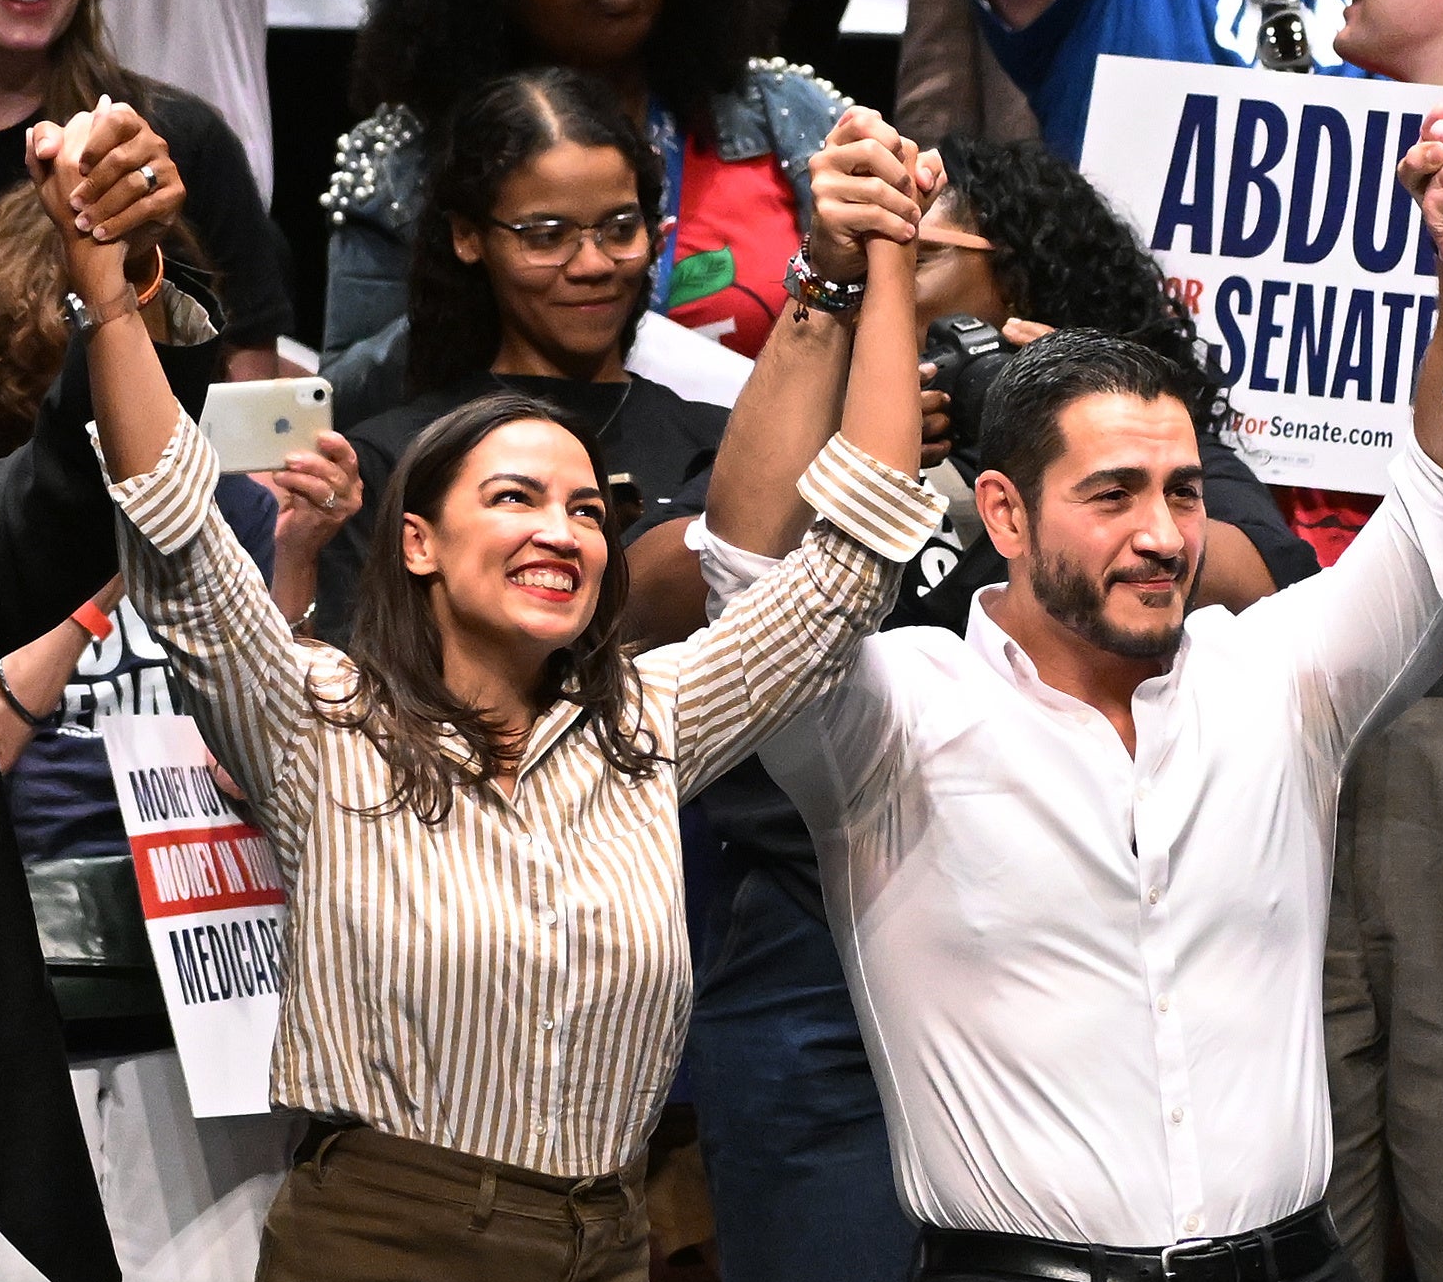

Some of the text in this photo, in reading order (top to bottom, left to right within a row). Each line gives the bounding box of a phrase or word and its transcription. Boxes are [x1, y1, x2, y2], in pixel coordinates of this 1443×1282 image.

[1213, 412, 1394, 448] ForSenate.com
[129, 768, 188, 822] MONEY
[148, 842, 223, 904] MONEY
[213, 840, 247, 894] IN
